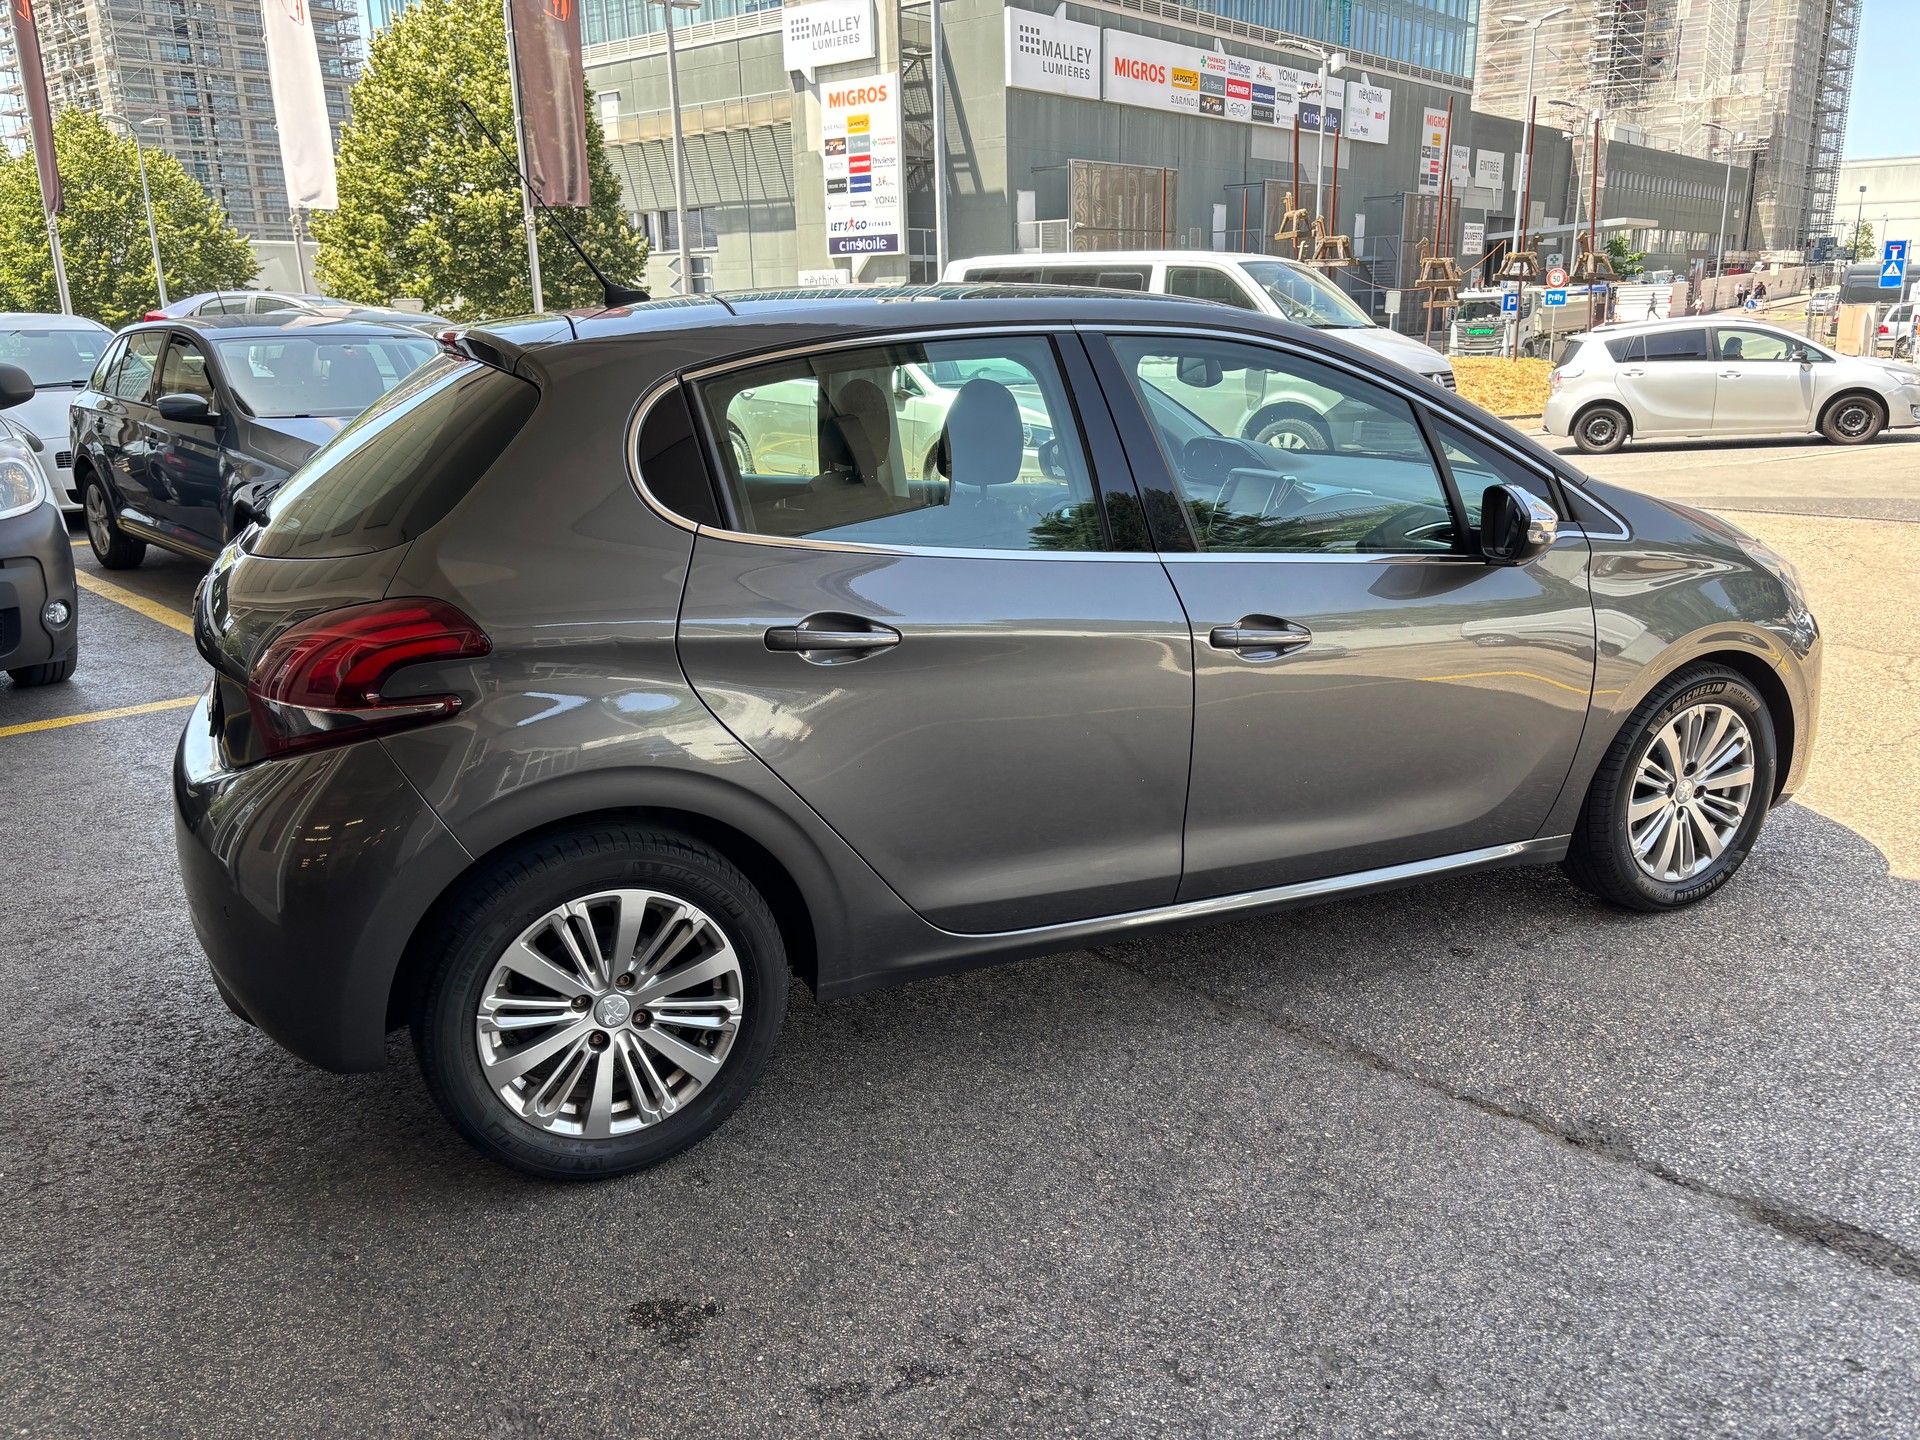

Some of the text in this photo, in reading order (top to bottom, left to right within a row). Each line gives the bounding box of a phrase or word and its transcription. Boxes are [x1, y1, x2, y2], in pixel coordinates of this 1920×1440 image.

[812, 15, 860, 37] MALLEY
[812, 33, 860, 50] LUMIÈRES
[1042, 40, 1092, 64] MALLEY
[1042, 61, 1091, 80] LUMIÈRES
[1114, 56, 1166, 84] MIGROS
[1278, 69, 1298, 83] YONA!
[1179, 75, 1193, 84] POSTE
[828, 85, 887, 109] MIGROS
[1228, 84, 1250, 95] DENNER
[1480, 159, 1500, 173] ENTRÉE
[874, 195, 897, 205] YONA!
[831, 222, 848, 231] LET'S
[855, 220, 867, 230] GO
[1552, 275, 1561, 283] 50
[1507, 296, 1517, 310] P
[1673, 683, 1724, 712] MICHELIN
[1729, 687, 1753, 705] PRIMACY
[657, 866, 745, 919] MICHELIN
[1675, 871, 1725, 902] MICHELIN
